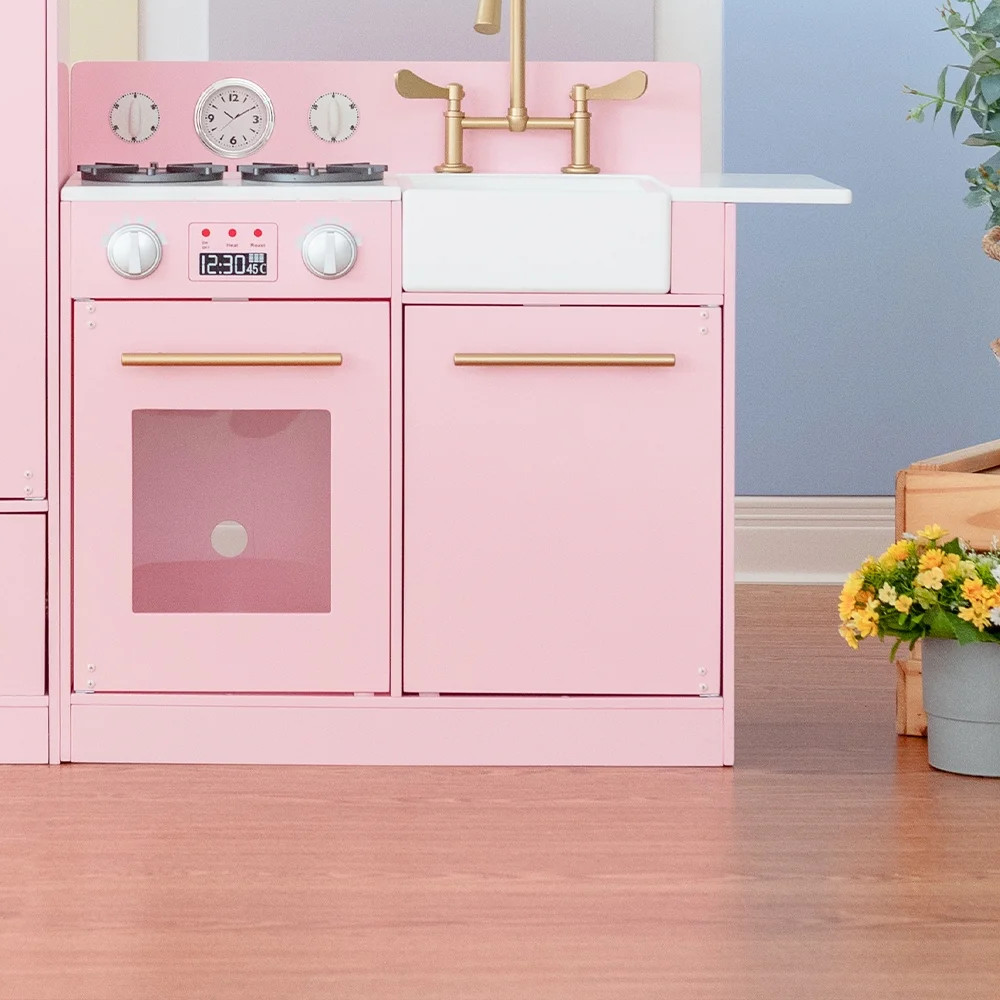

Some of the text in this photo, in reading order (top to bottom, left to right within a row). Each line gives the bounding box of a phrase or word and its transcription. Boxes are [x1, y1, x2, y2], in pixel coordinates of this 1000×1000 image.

[228, 93, 239, 102] 12
[207, 113, 215, 122] 9
[252, 115, 259, 124] 3
[229, 136, 237, 145] 6
[201, 254, 246, 275] 12:30
[246, 263, 258, 275] 45
